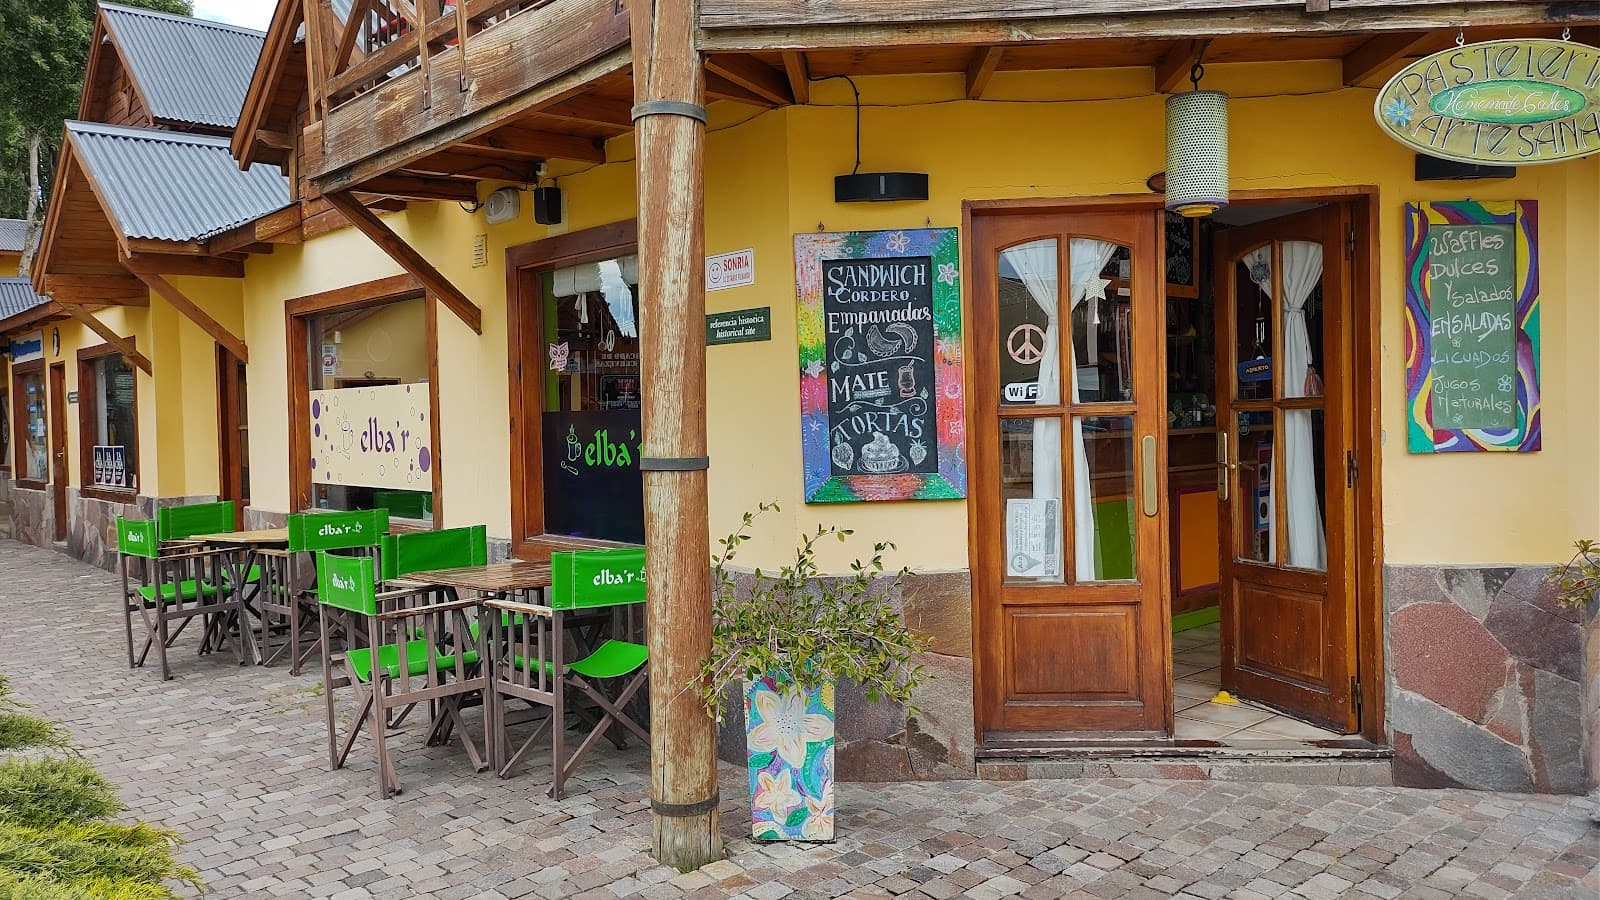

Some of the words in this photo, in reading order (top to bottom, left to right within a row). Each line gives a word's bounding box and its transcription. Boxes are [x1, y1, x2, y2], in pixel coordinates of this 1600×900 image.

[1435, 85, 1520, 116] Homemade
[1522, 90, 1571, 113] Cakes
[827, 264, 927, 297] SANDWICH
[710, 317, 737, 328] referencia
[716, 326, 744, 338] historical
[827, 301, 932, 334] Empanadas
[1431, 350, 1510, 368] LICUADOS
[830, 371, 890, 403] MATE
[830, 411, 925, 440] TORTAS
[593, 568, 634, 586] elba'r
